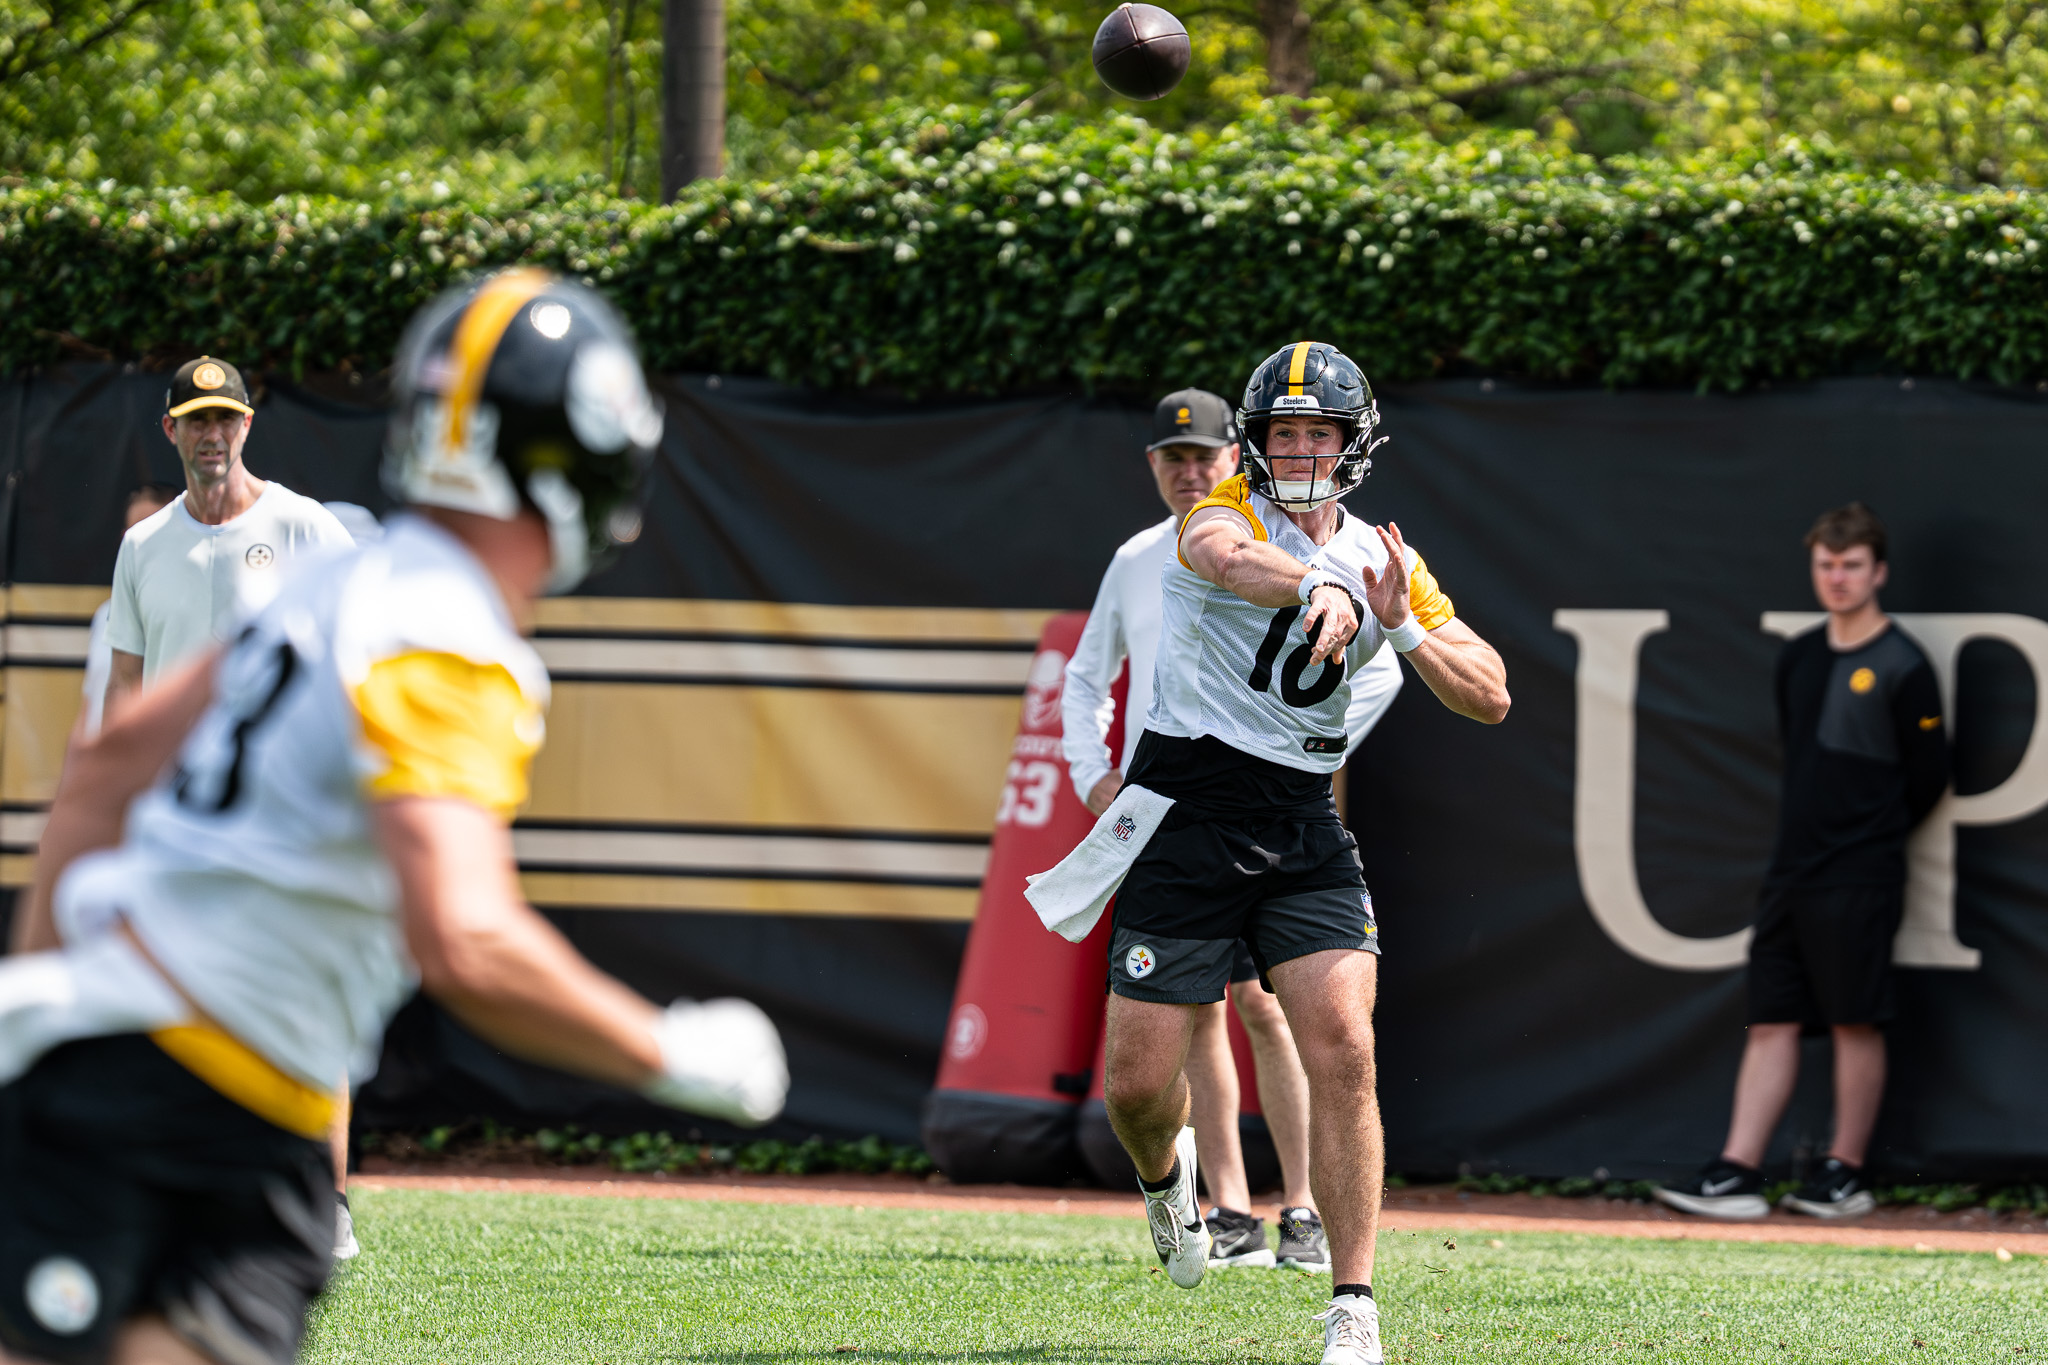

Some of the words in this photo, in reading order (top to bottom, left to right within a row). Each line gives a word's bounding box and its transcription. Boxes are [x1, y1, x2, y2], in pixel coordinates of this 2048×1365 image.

[1282, 397, 1307, 405] Steelers
[1248, 597, 1364, 709] 18
[1113, 822, 1131, 841] NFL
